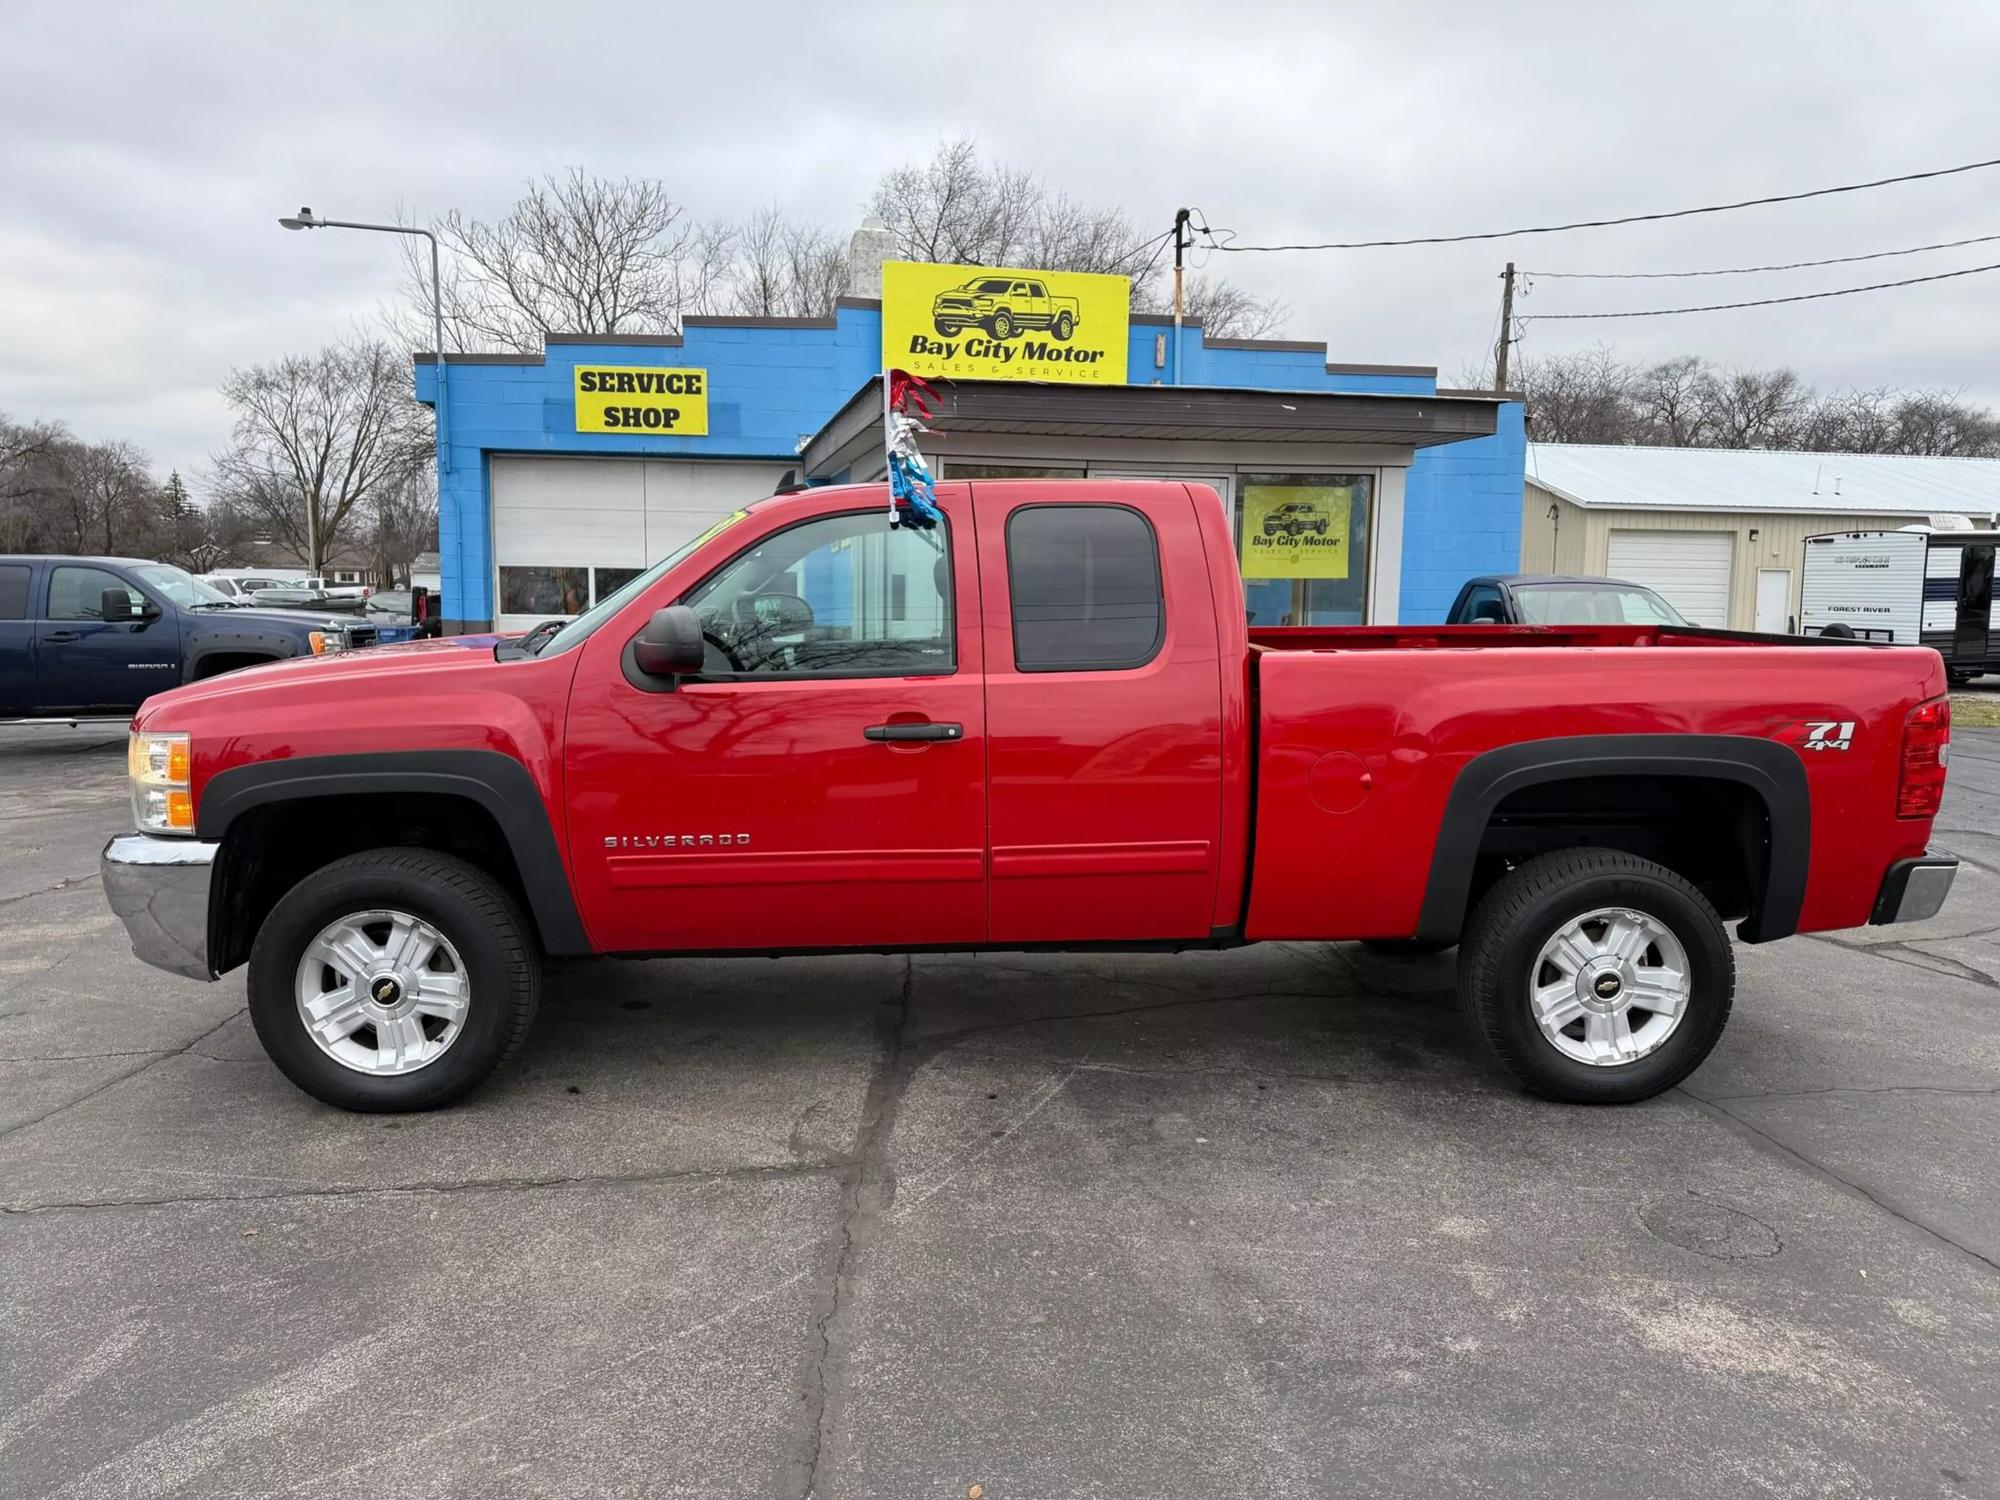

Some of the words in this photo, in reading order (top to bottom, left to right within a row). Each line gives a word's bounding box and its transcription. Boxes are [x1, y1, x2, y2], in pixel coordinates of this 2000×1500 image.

[909, 335, 960, 360] Bay
[965, 338, 1018, 363] City
[1022, 341, 1104, 363] Motor
[913, 361, 975, 373] SALES
[991, 365, 1000, 374] &
[1016, 366, 1100, 378] SERVICE
[580, 371, 702, 395] SERVICE
[603, 406, 680, 428] SHOP
[1252, 535, 1276, 548] Bay
[1276, 535, 1301, 548] City
[1302, 535, 1341, 546] Motor
[604, 833, 751, 848] SILVERADO
